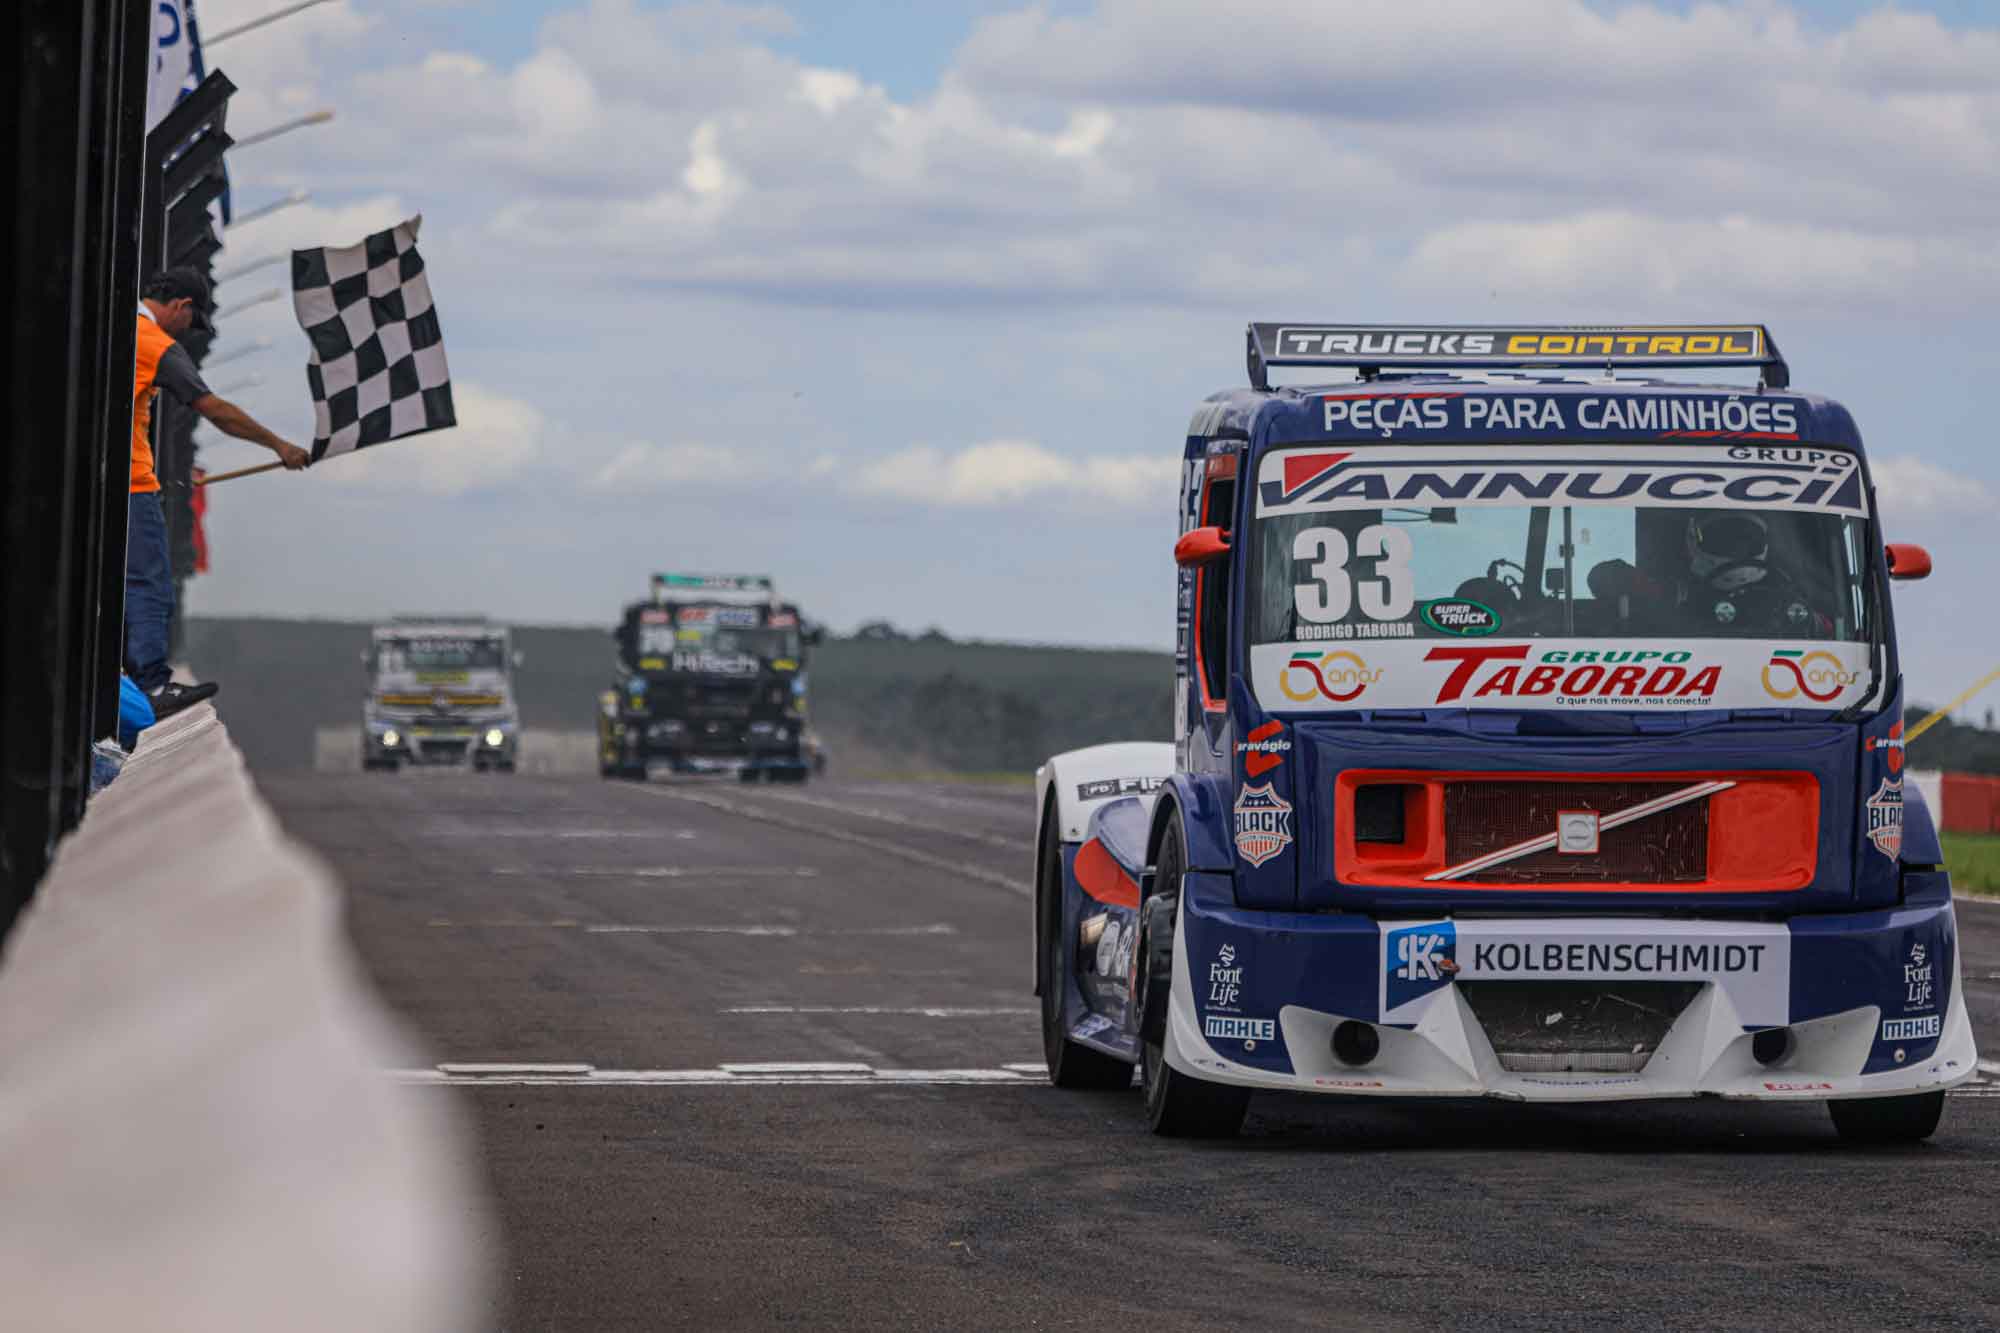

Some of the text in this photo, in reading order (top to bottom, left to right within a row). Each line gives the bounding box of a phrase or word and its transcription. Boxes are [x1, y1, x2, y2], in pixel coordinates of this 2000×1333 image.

[1288, 335, 1750, 354] TRUCKS CONTROL
[1323, 393, 1798, 438] PEÇAS PARA CAMINHÕES
[1727, 446, 1852, 467] GRUPO
[1292, 524, 1416, 624] 33
[1434, 605, 1472, 615] SUPER
[1440, 612, 1488, 625] TRUCK
[1295, 622, 1415, 641] RODRIGO TABORDA
[1541, 649, 1692, 664] GRUPO
[1423, 644, 1723, 705] TABORDA
[1567, 698, 1588, 708] que
[1590, 698, 1609, 706] nos
[1645, 697, 1665, 706] nos
[1235, 811, 1289, 835] BLACK
[1474, 943, 1766, 973] KOLBENSCHMIDT
[1209, 963, 1243, 984] Font
[1903, 963, 1933, 983] Font
[1209, 983, 1240, 1006] Life
[1906, 981, 1933, 1005] Life
[1206, 1018, 1273, 1039] MAHLE
[1884, 1017, 1938, 1039] MAHLE
